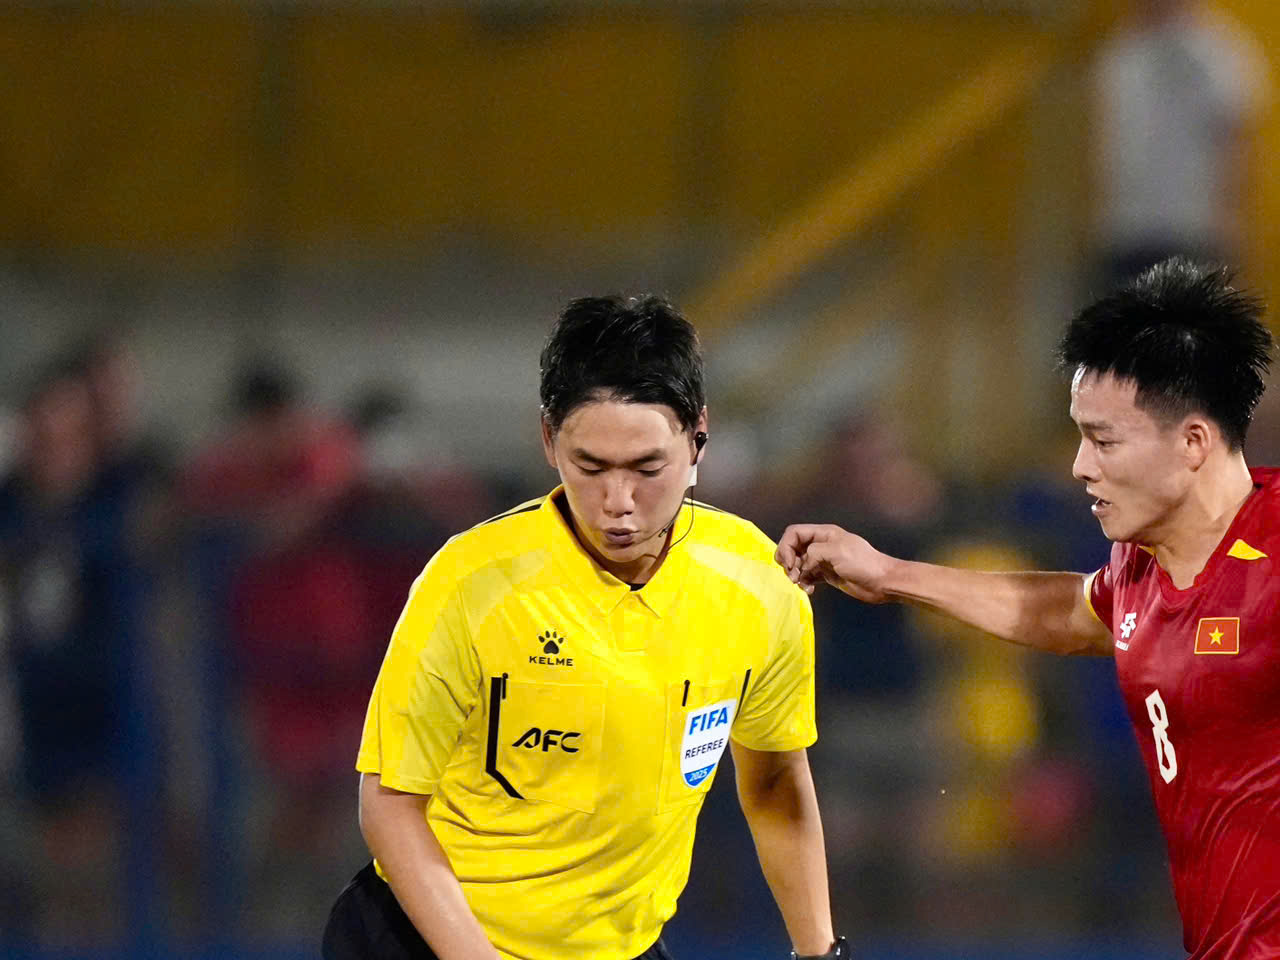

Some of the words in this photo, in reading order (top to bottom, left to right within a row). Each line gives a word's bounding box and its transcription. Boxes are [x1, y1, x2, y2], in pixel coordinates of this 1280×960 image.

[528, 655, 574, 667] KELME
[688, 706, 729, 736] FIFA
[511, 727, 582, 753] AFC
[684, 737, 725, 760] REFEREE
[1144, 688, 1178, 785] 8
